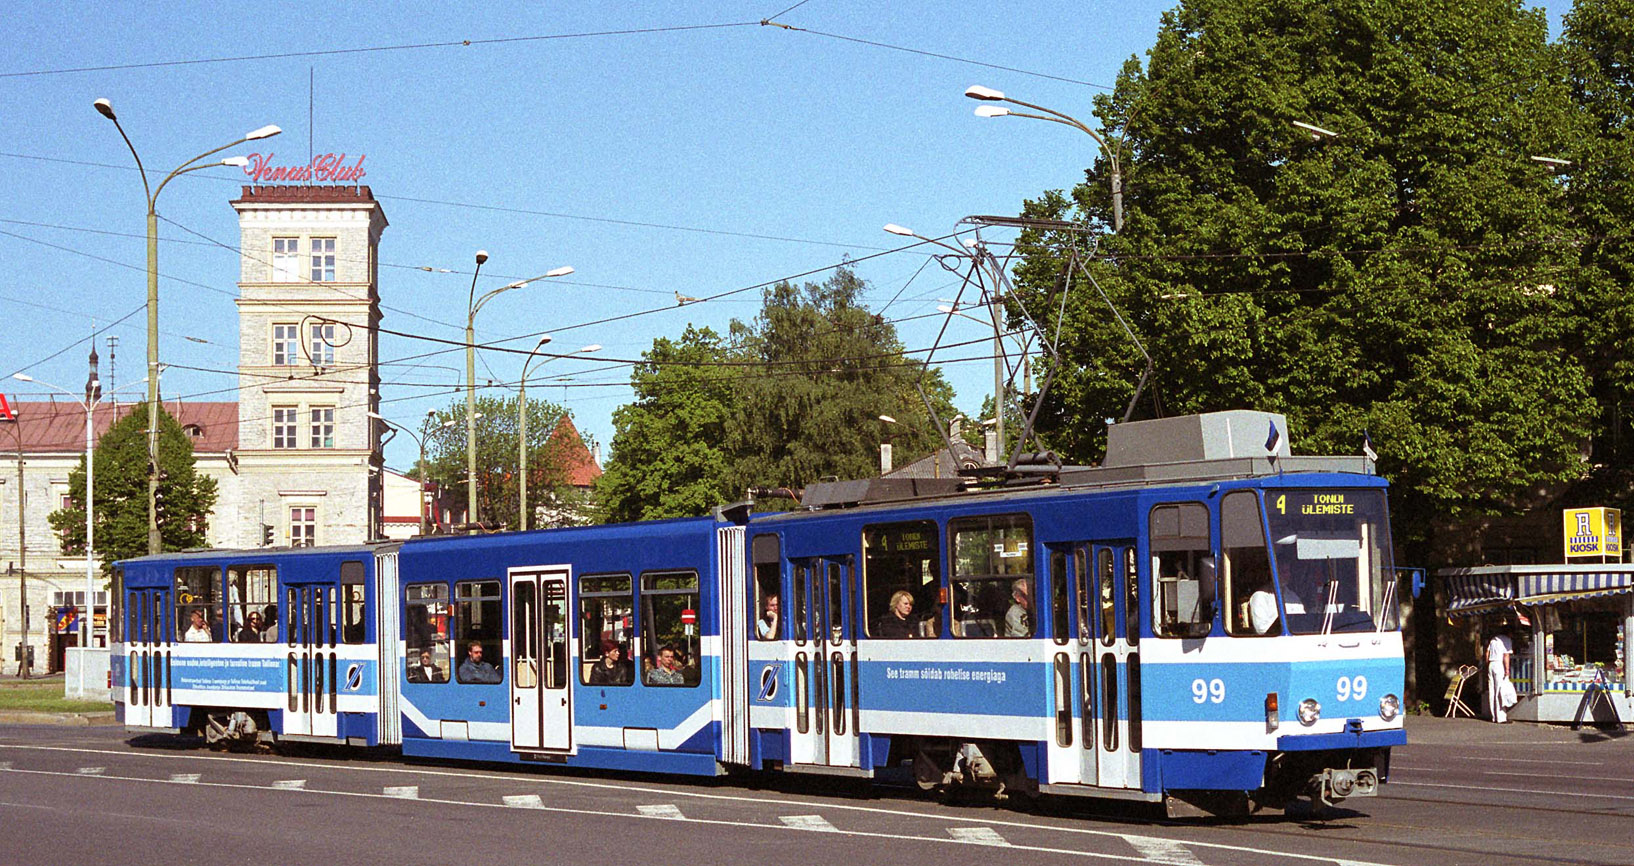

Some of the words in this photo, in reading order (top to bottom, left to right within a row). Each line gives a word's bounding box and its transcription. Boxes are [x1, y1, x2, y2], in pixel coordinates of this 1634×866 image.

[243, 152, 310, 182] Venus
[313, 152, 367, 182] Club
[1276, 494, 1286, 515] 4
[1302, 504, 1354, 515] ÜLEMISTE
[1575, 512, 1592, 536] R
[881, 535, 888, 551] 4
[1570, 543, 1599, 553] KIOSK
[1606, 543, 1619, 552] KIOSK
[886, 667, 899, 679] See
[899, 668, 920, 680] tramm
[920, 668, 943, 681] sõidab
[971, 669, 1006, 684] energiaga
[1191, 678, 1226, 704] 99
[1336, 675, 1368, 702] 99
